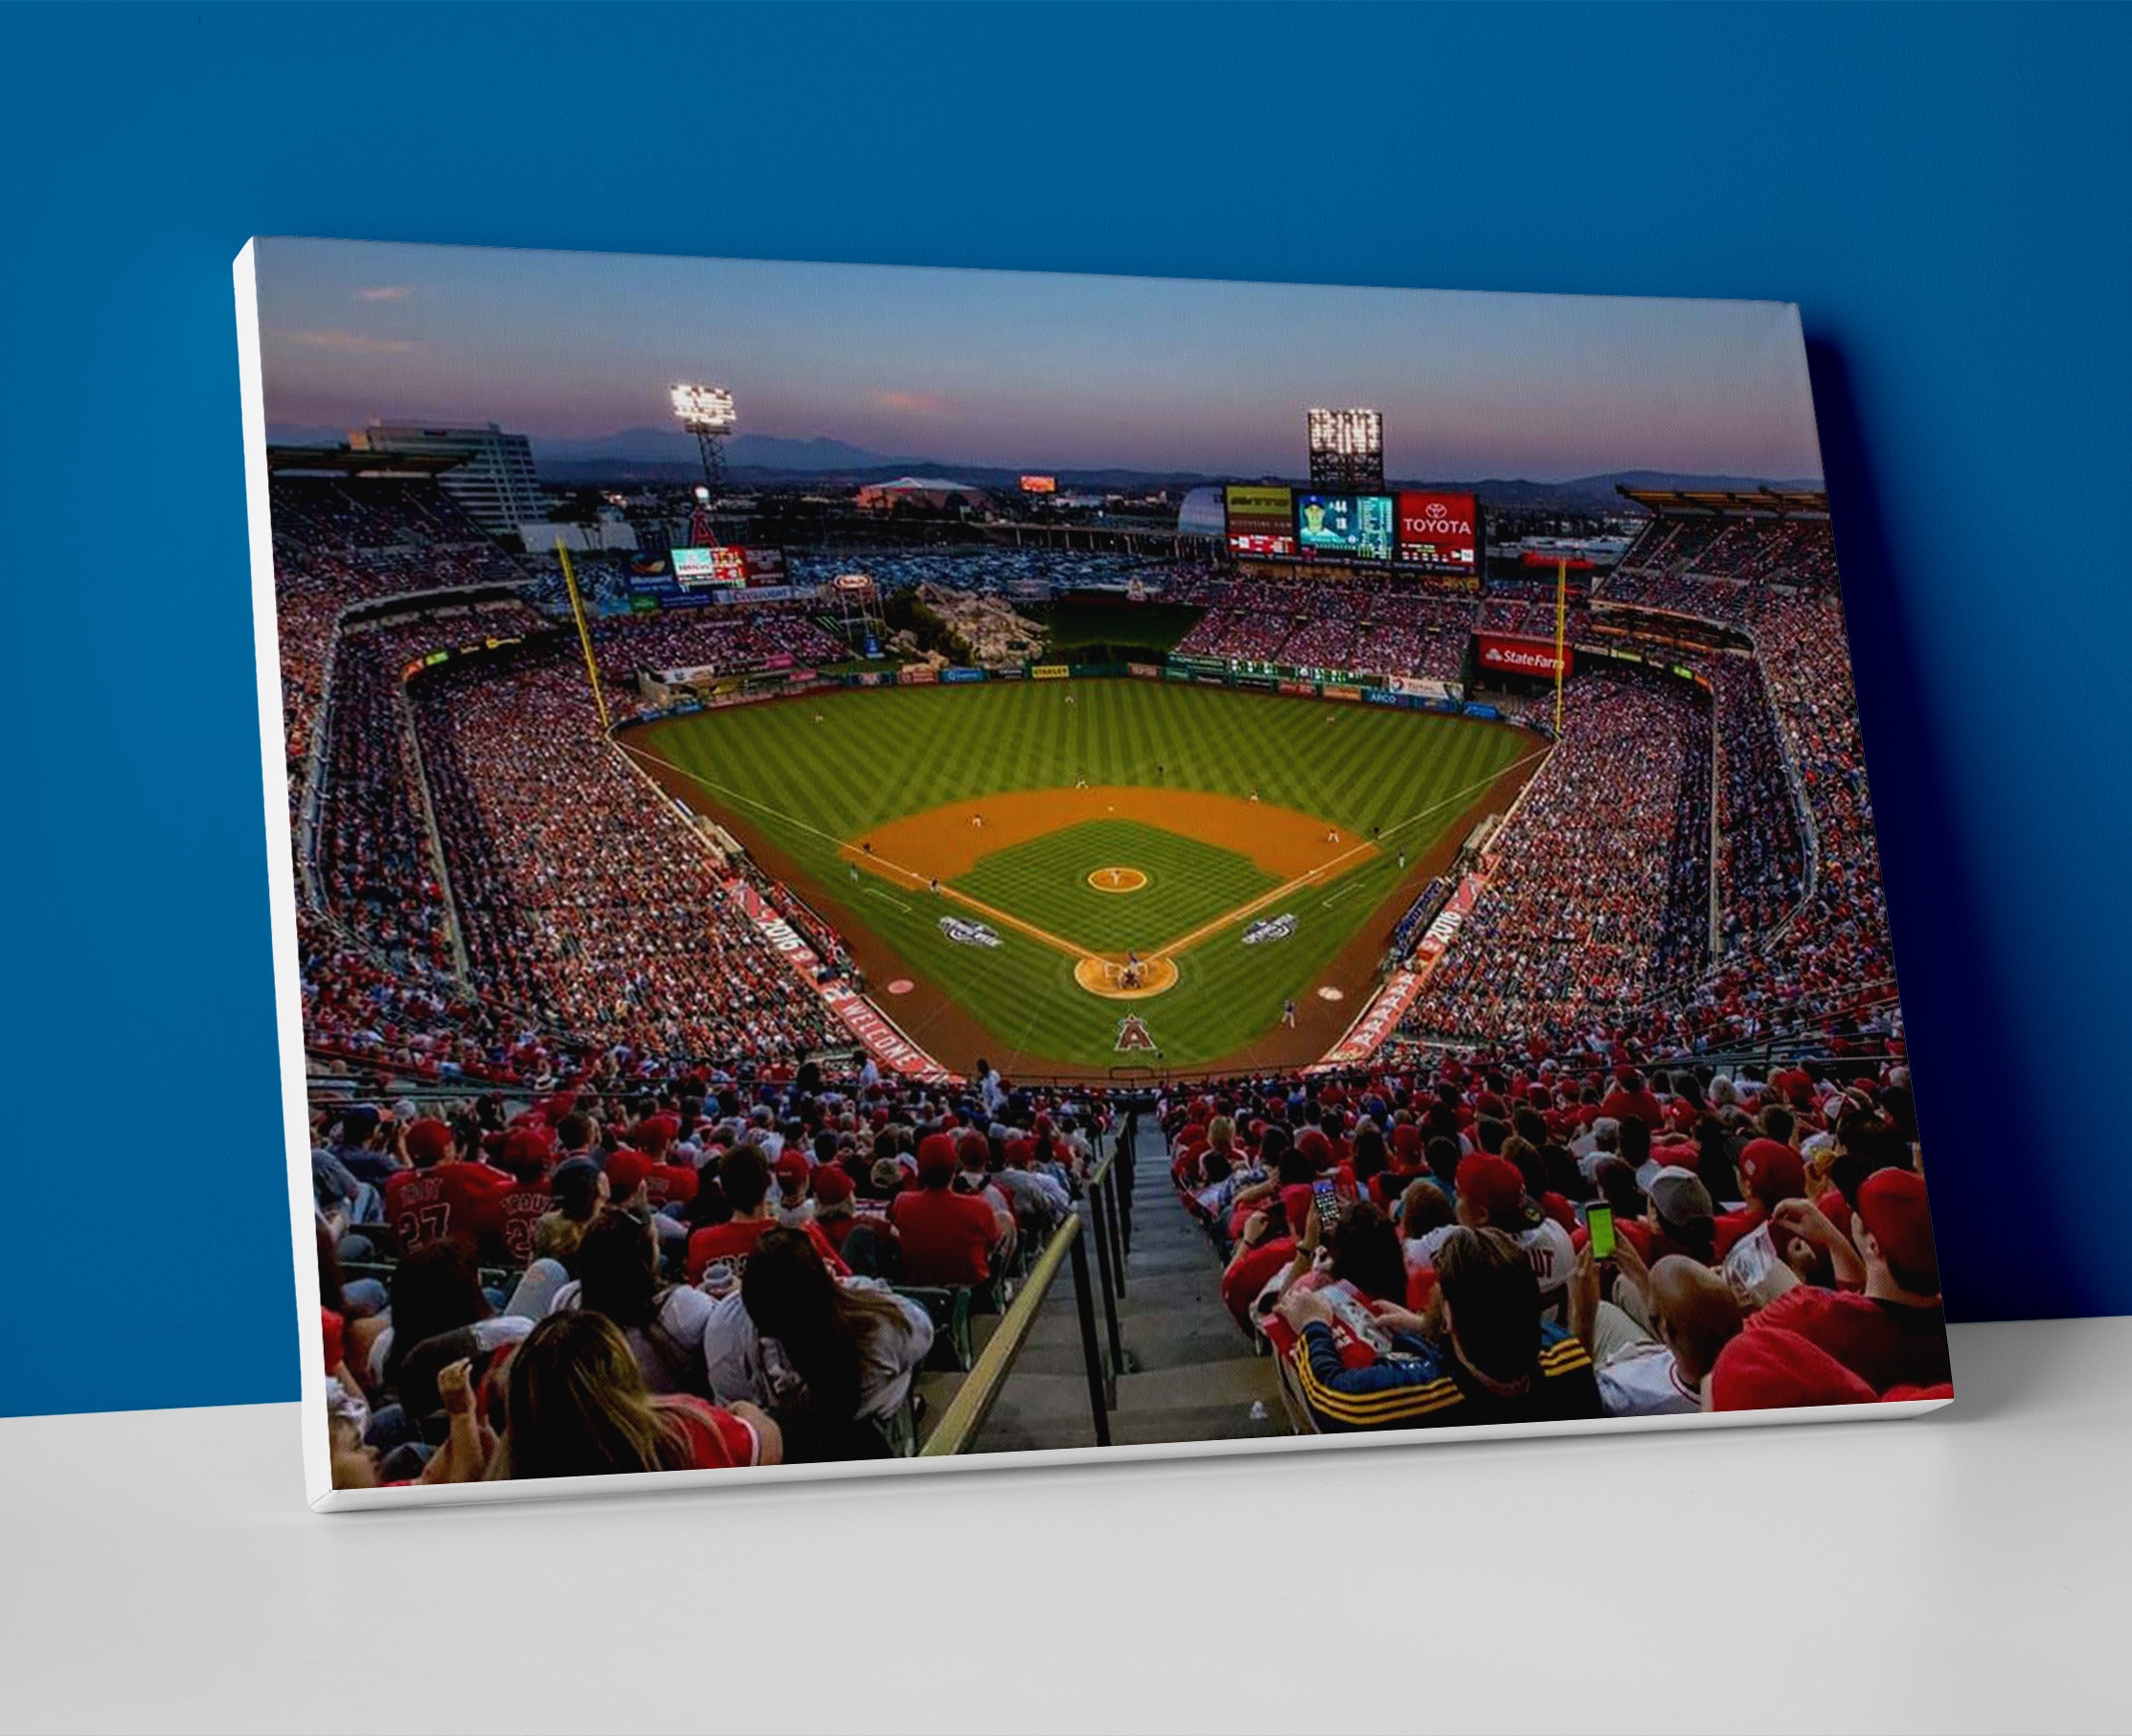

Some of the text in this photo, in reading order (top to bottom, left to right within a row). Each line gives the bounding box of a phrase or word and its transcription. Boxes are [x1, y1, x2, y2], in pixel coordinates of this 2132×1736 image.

[1404, 518, 1472, 534] TOYOTA
[758, 918, 806, 951] 2016
[840, 1001, 919, 1068] WELCOME
[398, 1202, 451, 1249] 27
